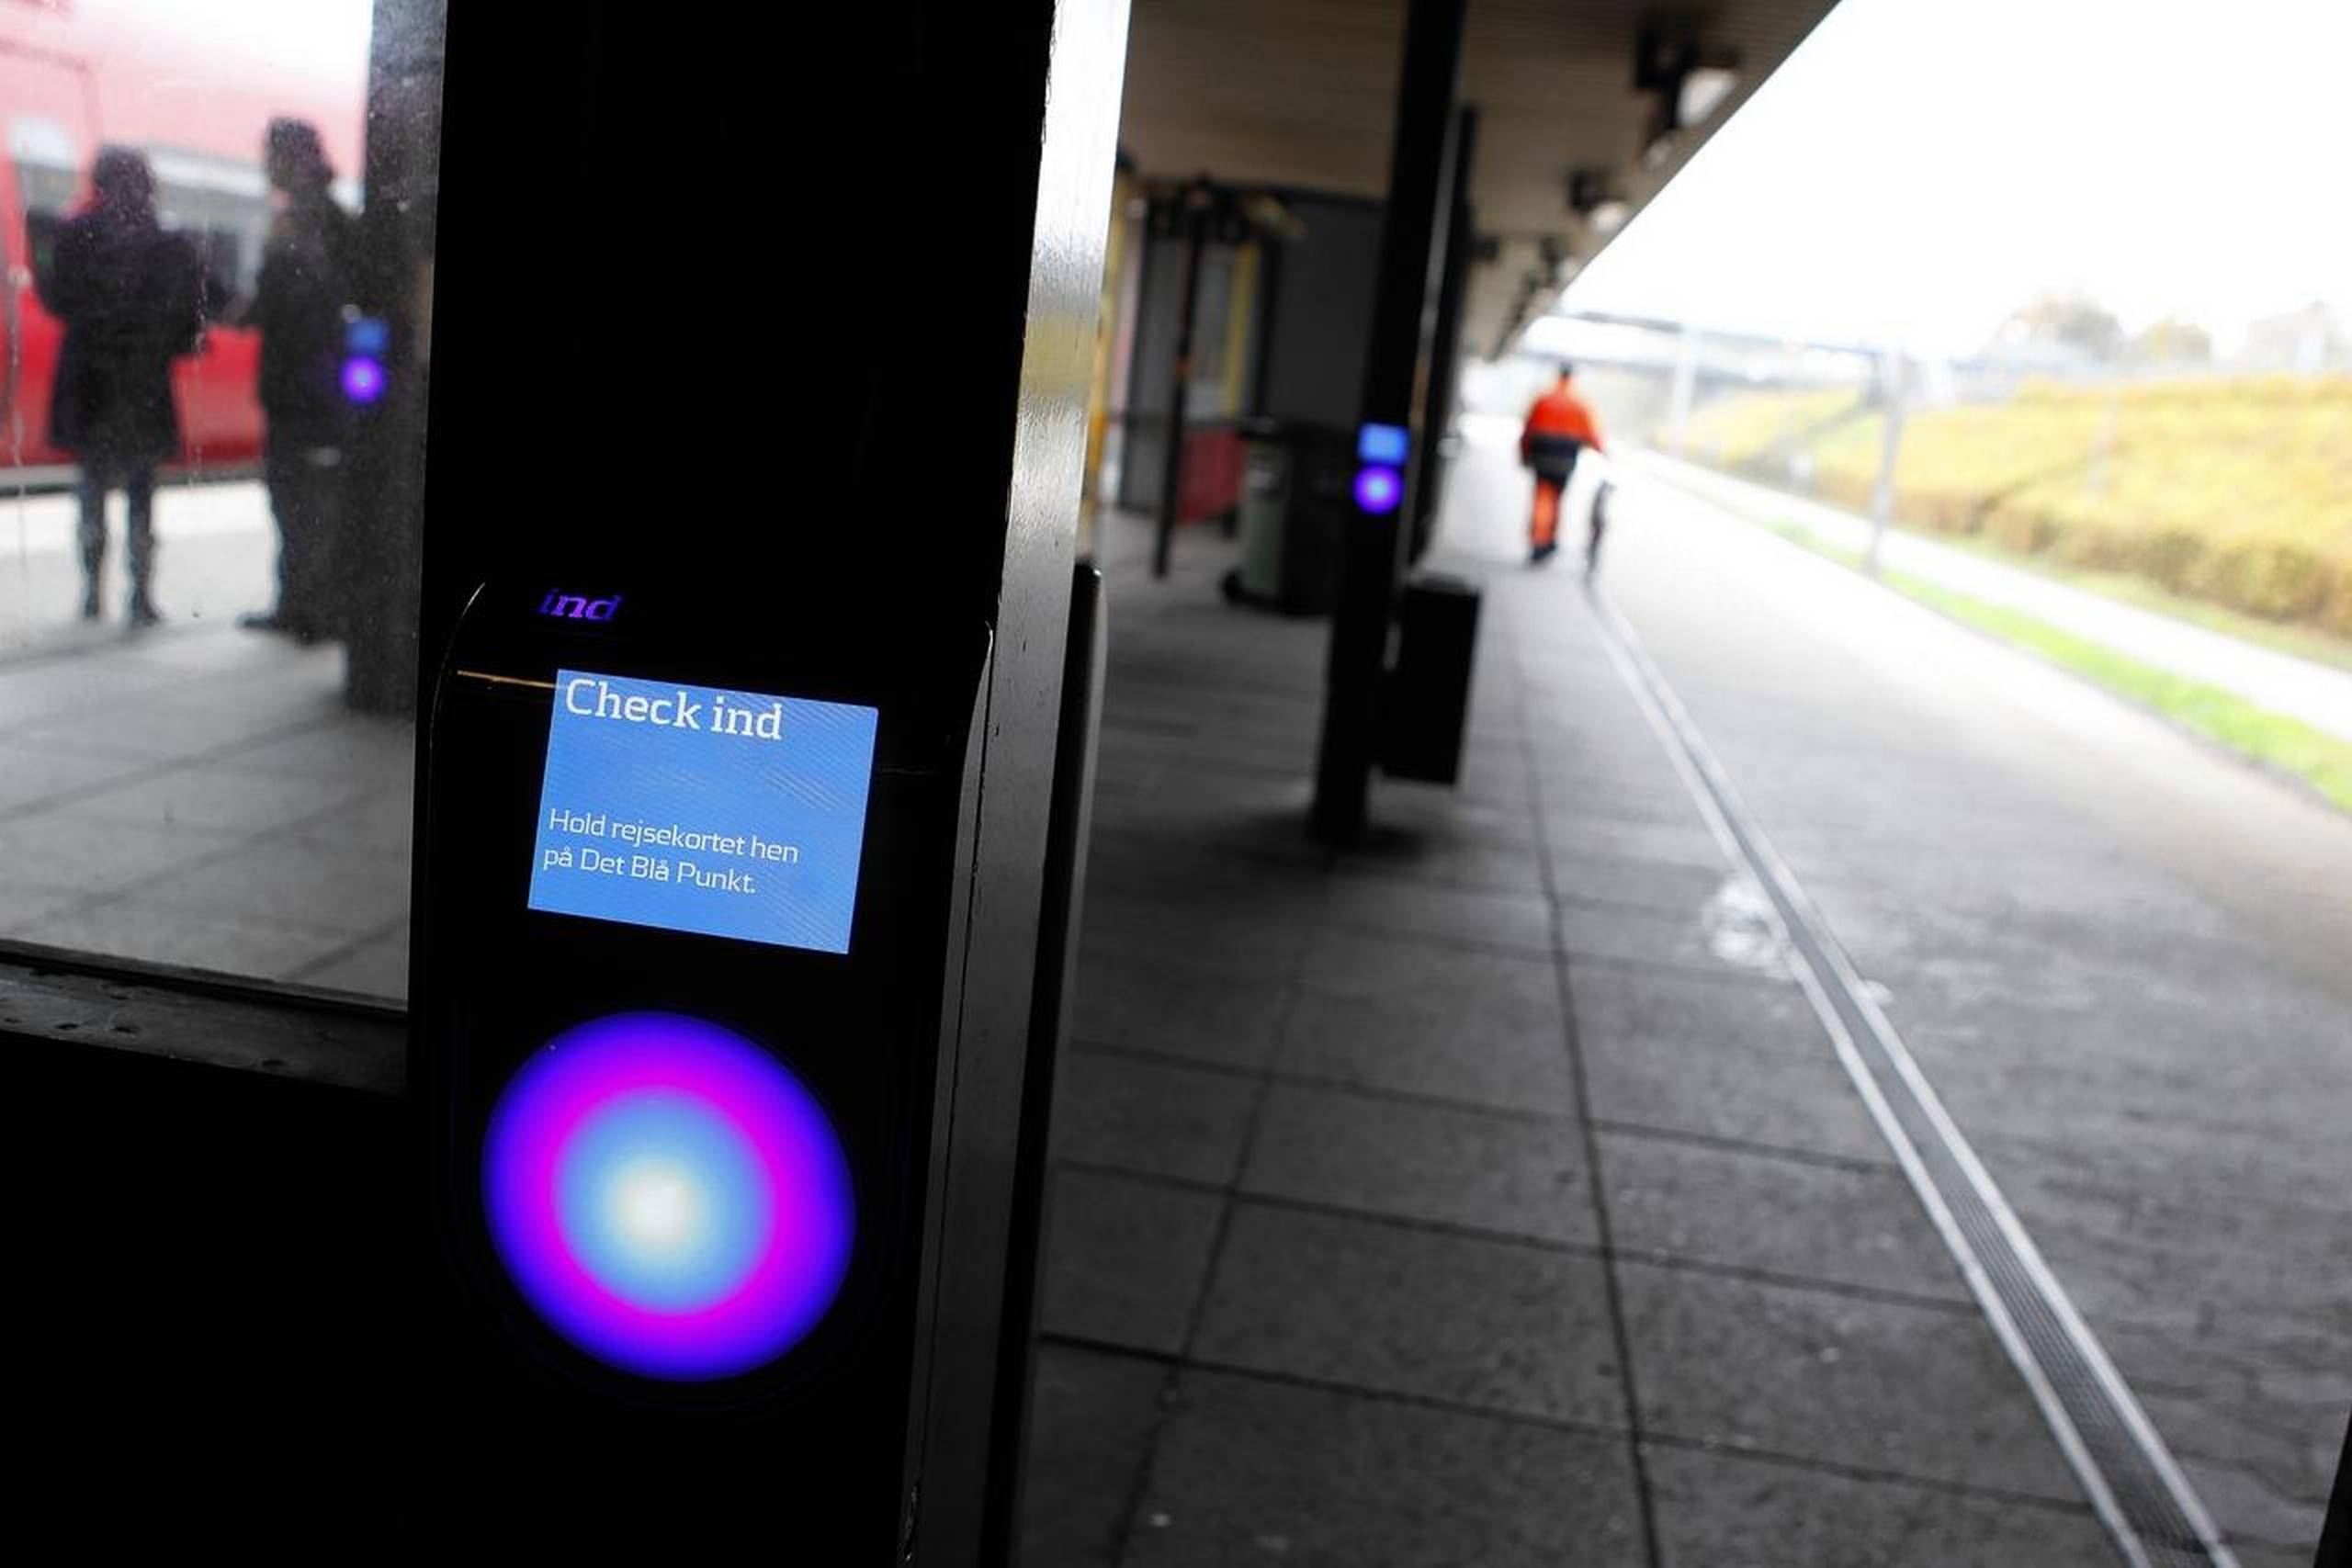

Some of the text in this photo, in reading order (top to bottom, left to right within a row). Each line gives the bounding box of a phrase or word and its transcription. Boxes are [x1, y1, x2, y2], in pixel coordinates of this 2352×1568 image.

[538, 588, 622, 621] ind
[566, 678, 783, 740] Check ind
[549, 808, 798, 863] Hold rejsekortet hen
[543, 846, 756, 894] på Det Blå Punkt.
